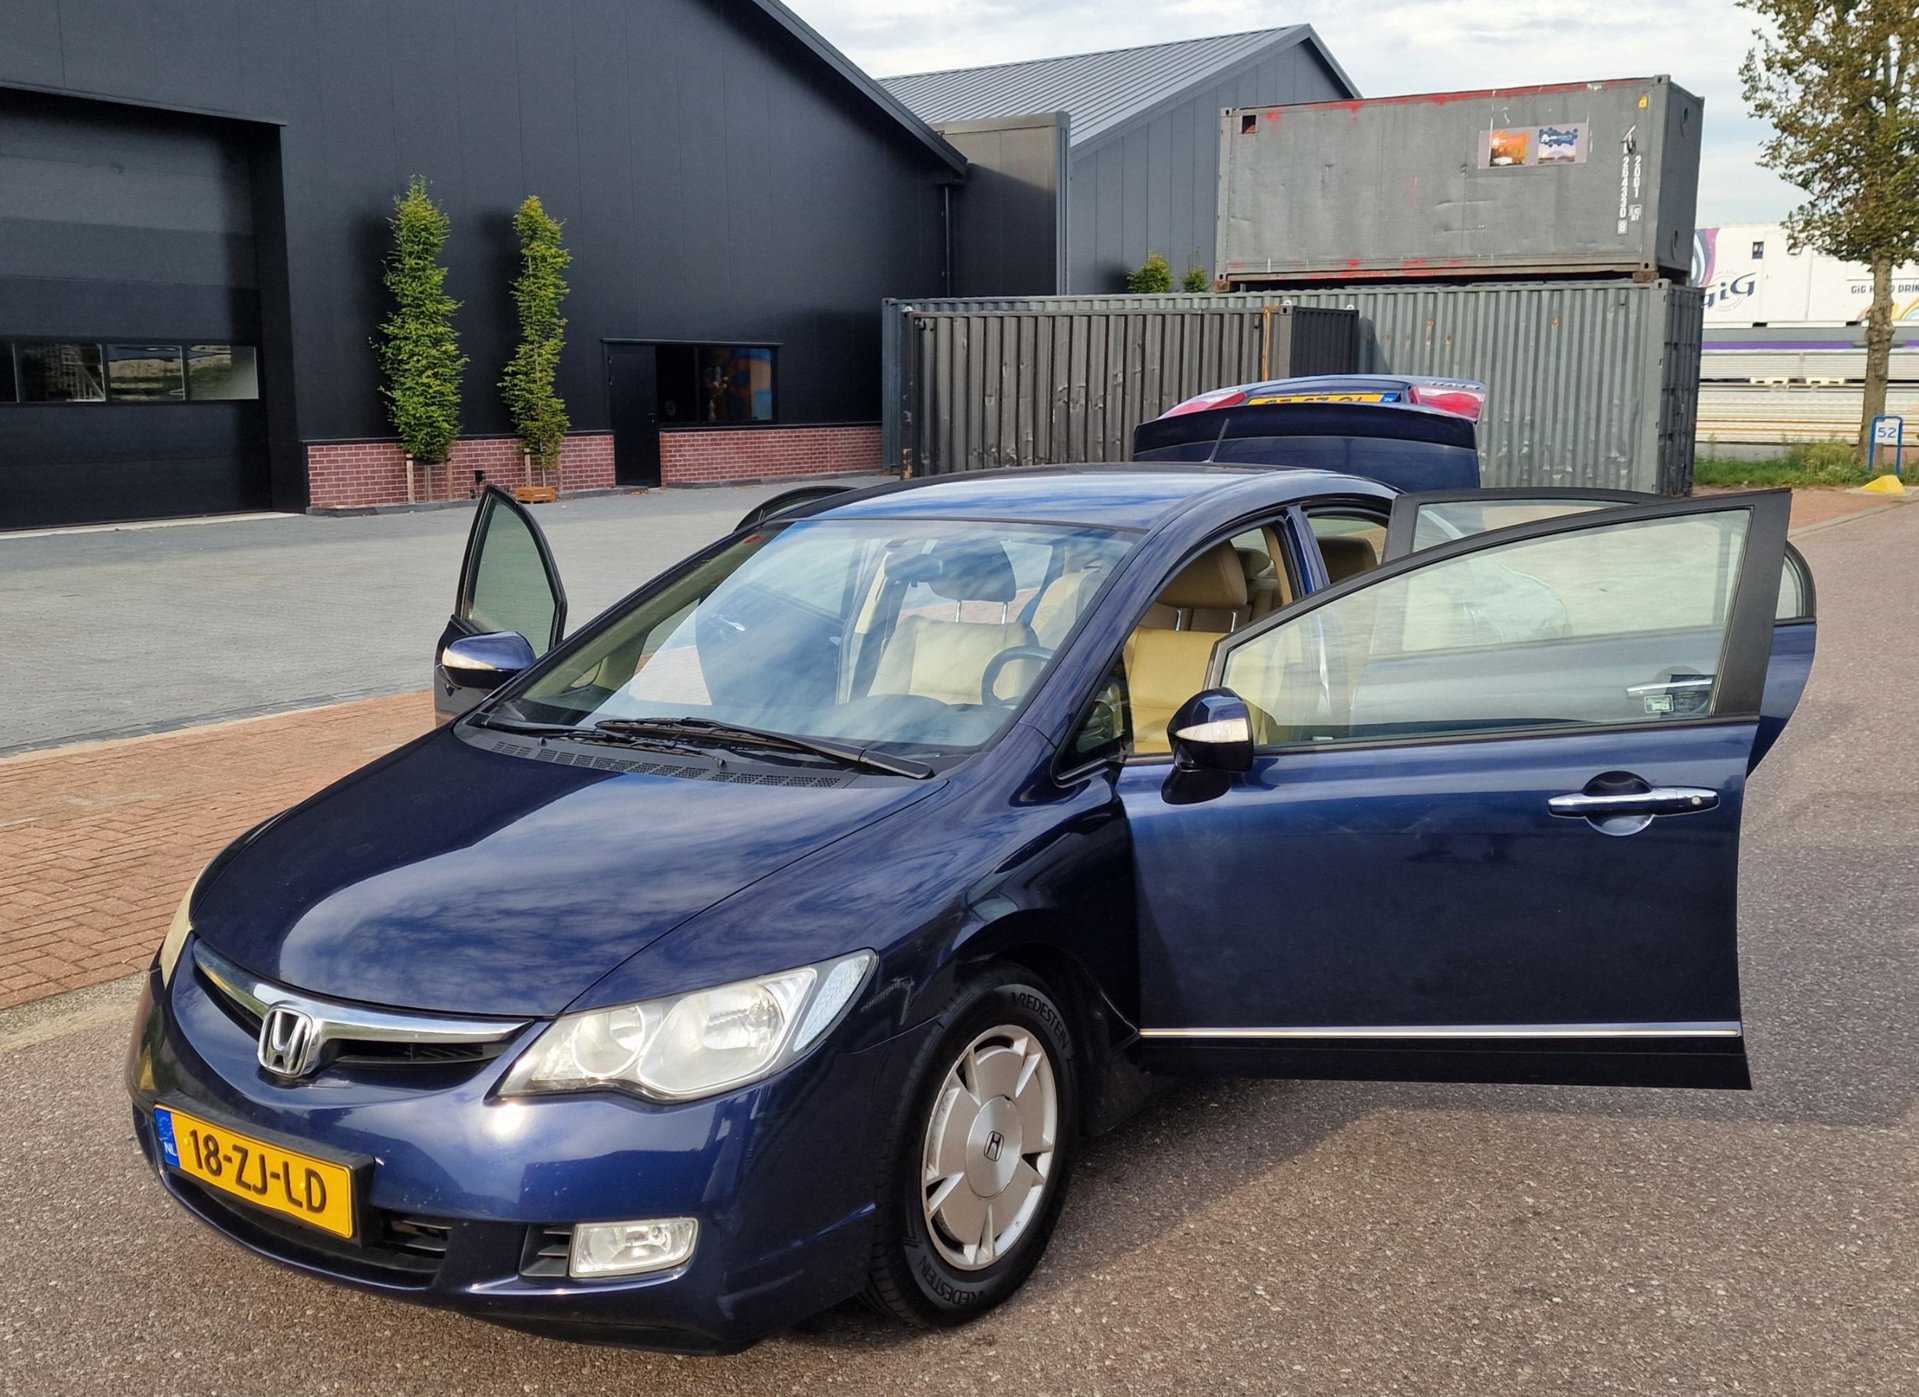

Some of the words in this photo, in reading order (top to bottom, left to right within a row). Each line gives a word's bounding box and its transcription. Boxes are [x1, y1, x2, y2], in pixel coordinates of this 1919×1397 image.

[1878, 427, 1896, 438] 52
[164, 1142, 178, 1157] NL
[189, 1129, 327, 1214] 18-ZJ-LD
